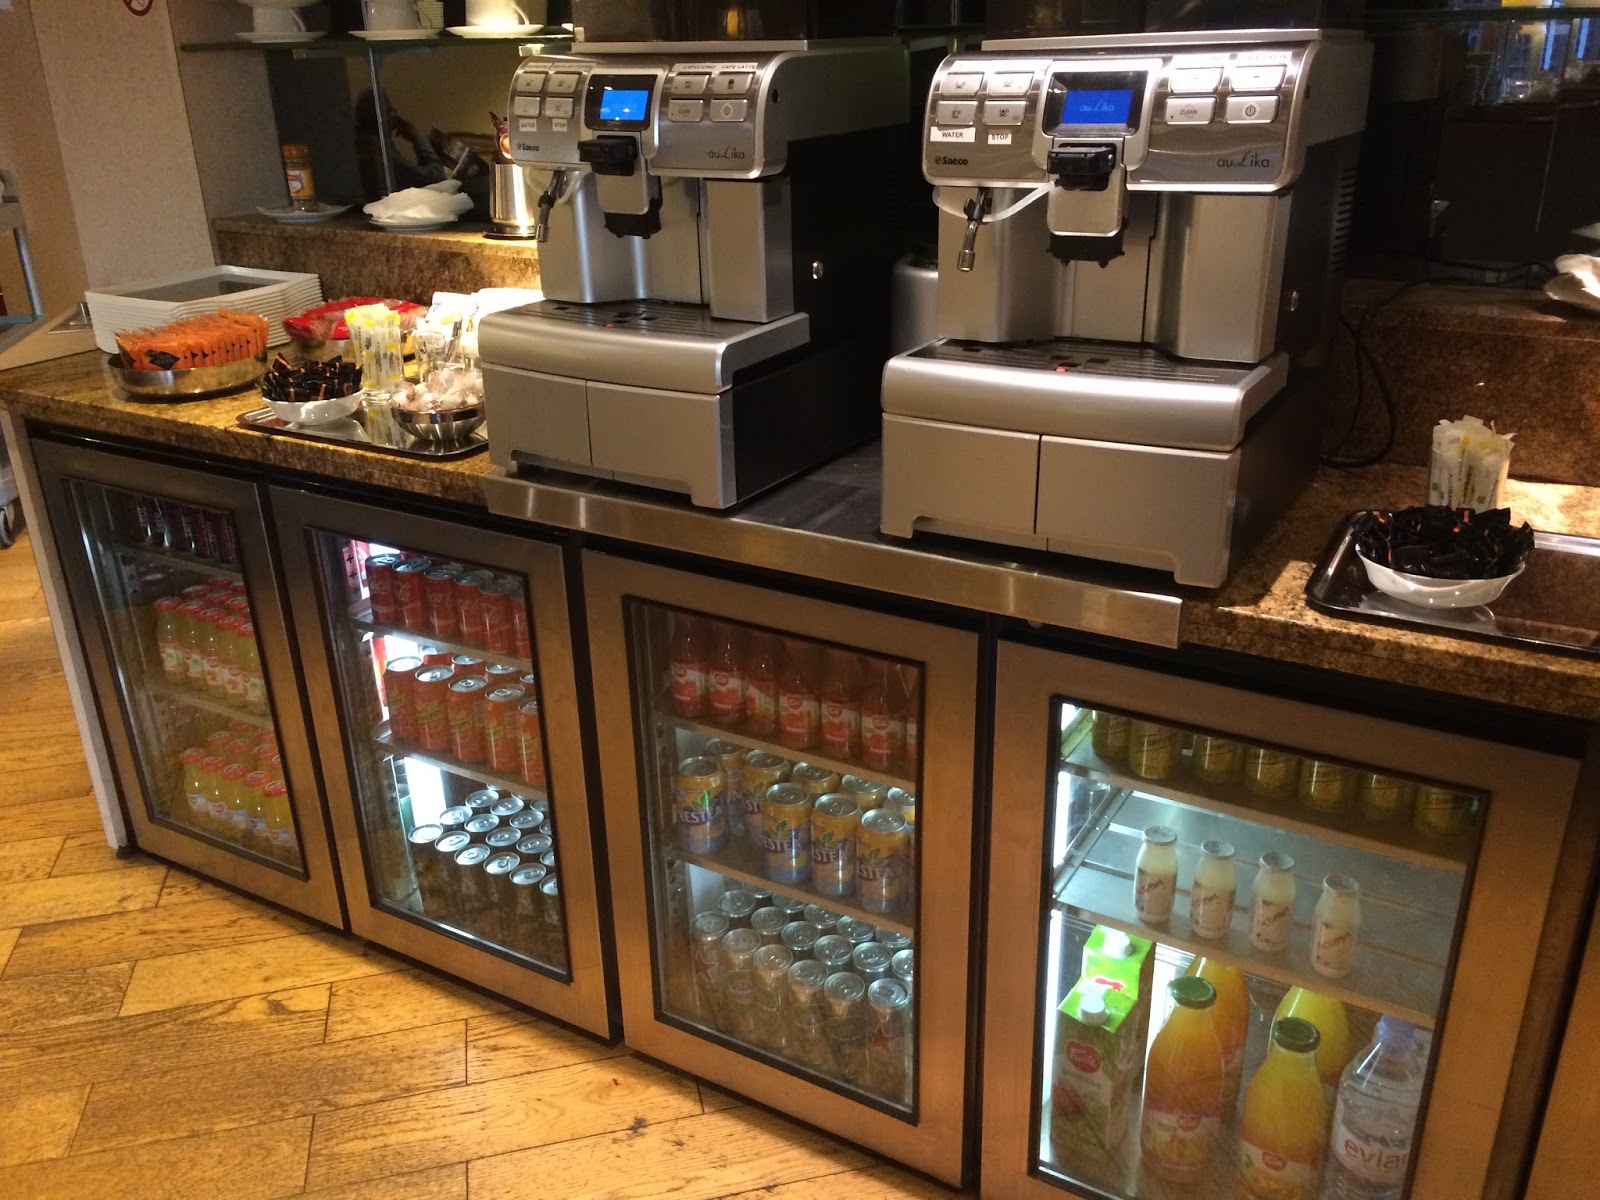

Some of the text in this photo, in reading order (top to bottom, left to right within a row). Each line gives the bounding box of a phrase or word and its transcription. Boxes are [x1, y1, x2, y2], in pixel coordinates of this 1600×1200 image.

[520, 121, 536, 129] WATER
[521, 143, 540, 152] Saeco
[942, 156, 969, 166] Saeco
[136, 506, 147, 528] zero
[181, 515, 193, 538] zero
